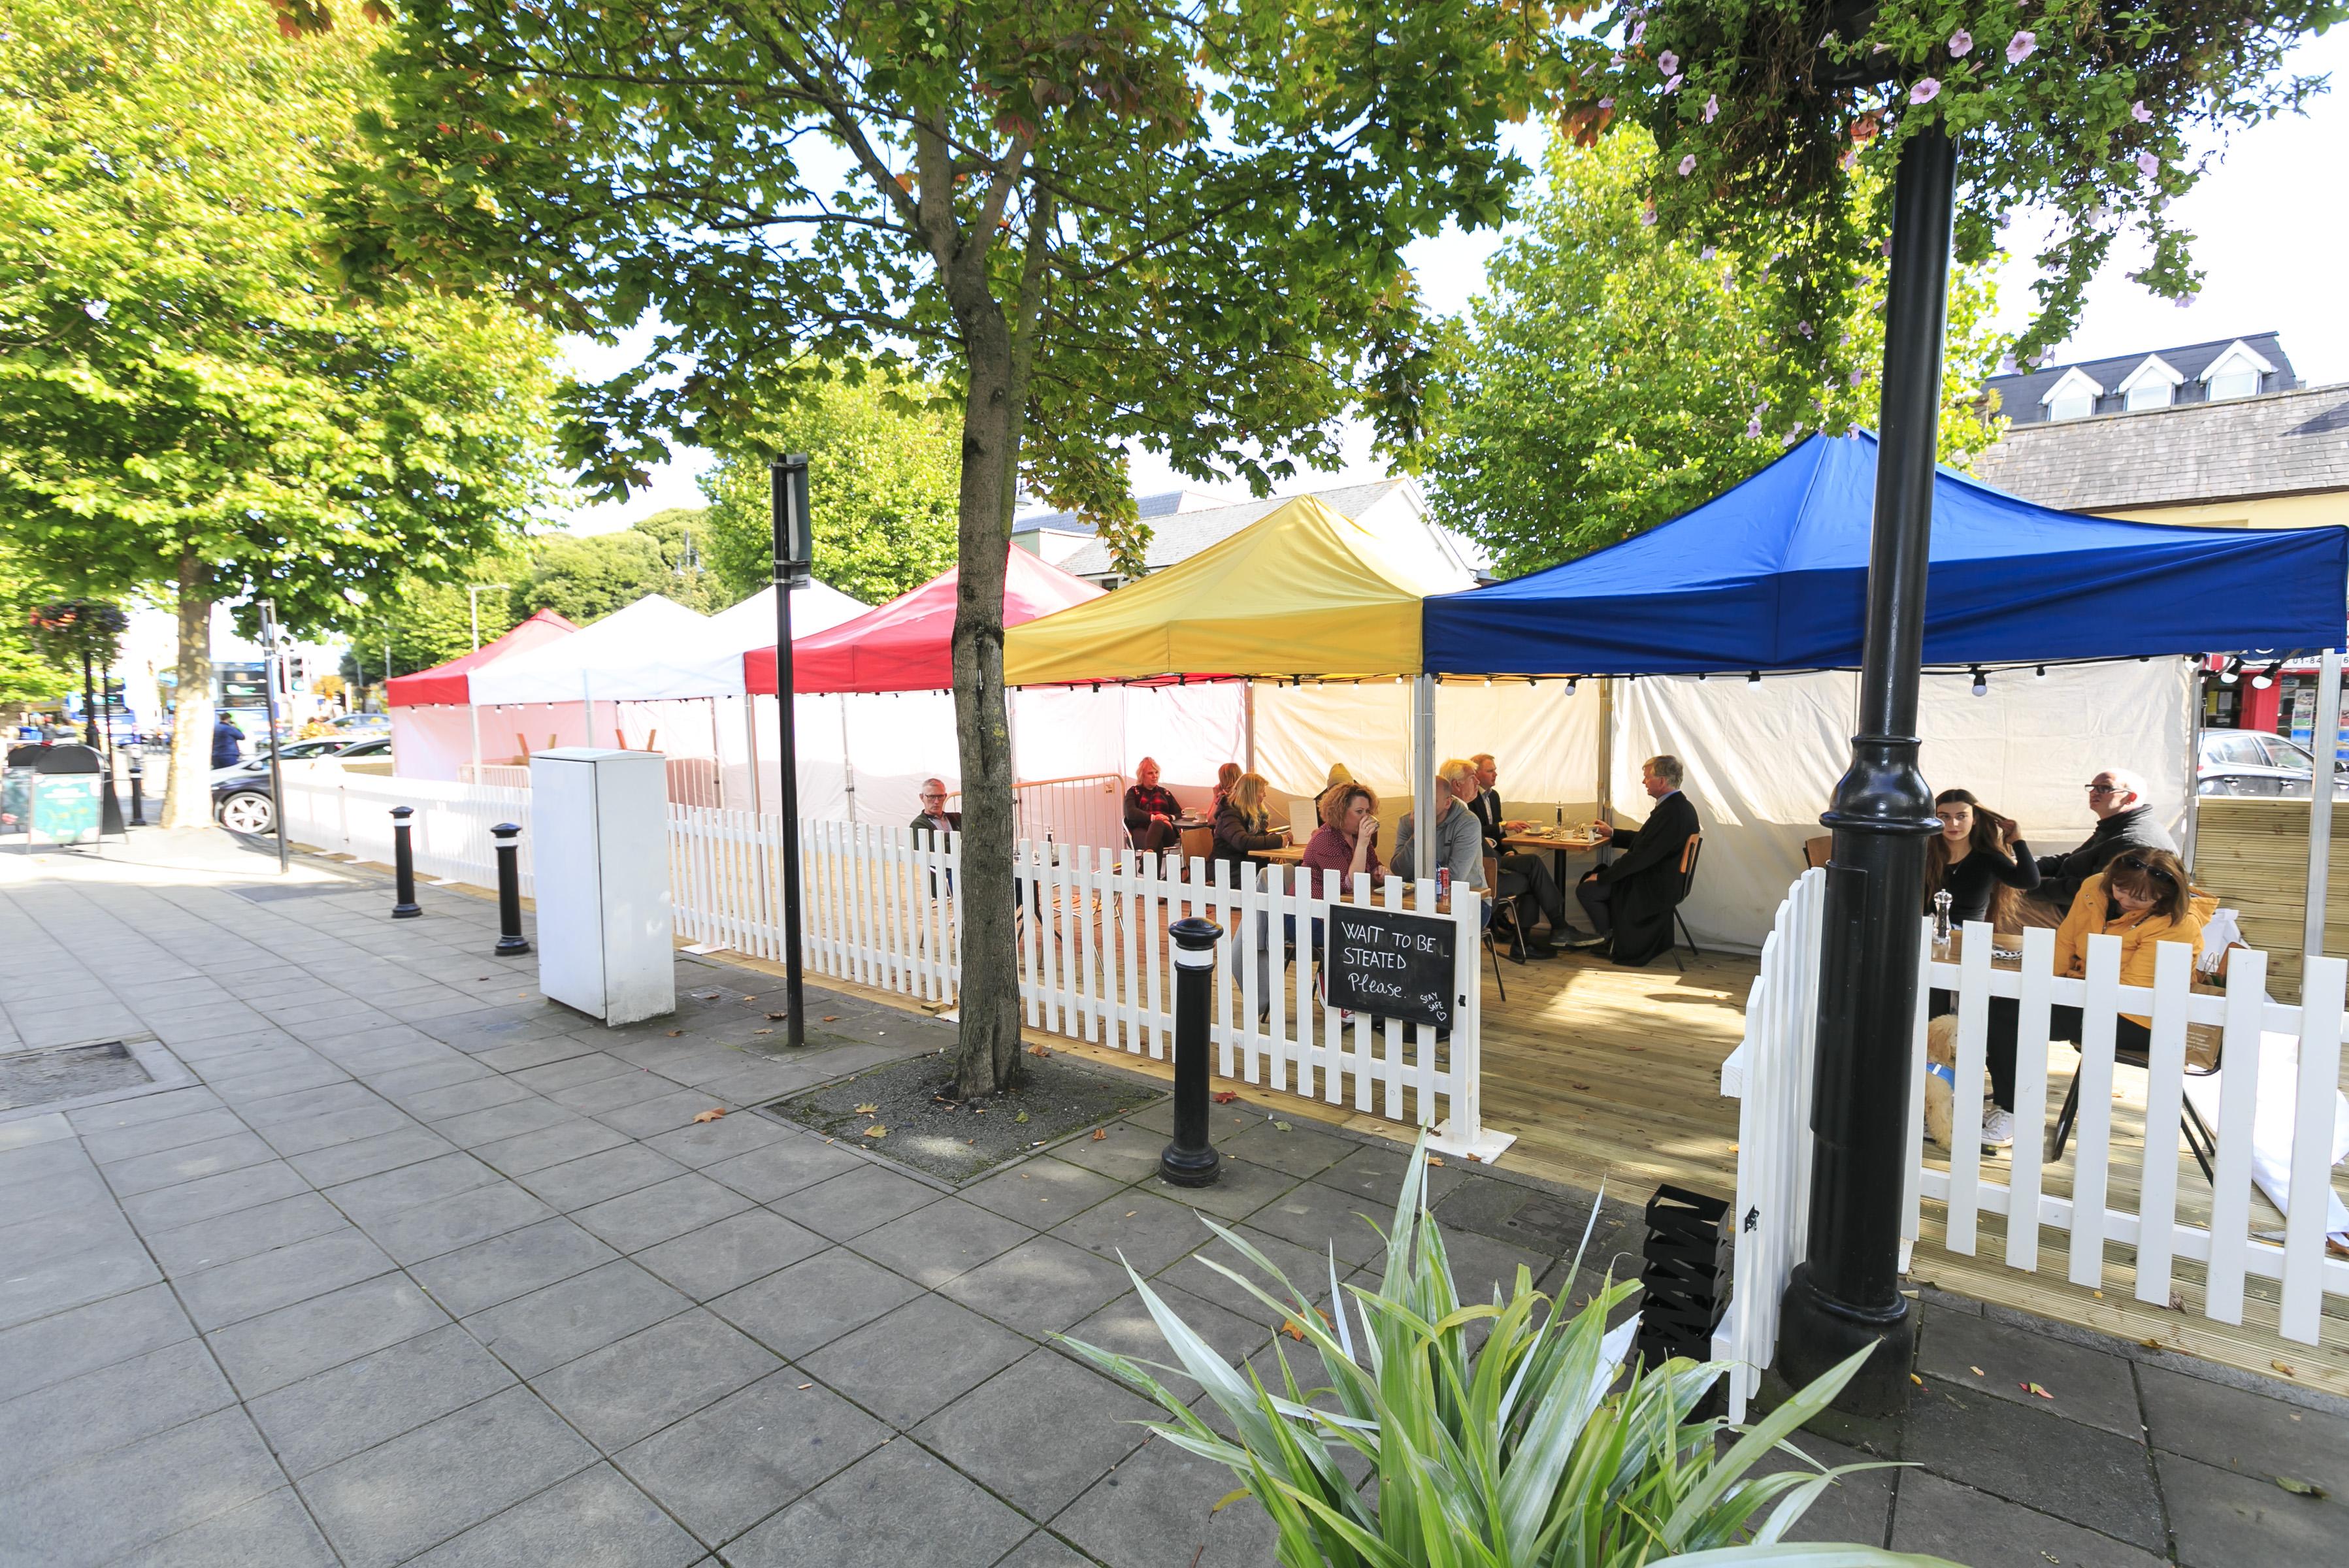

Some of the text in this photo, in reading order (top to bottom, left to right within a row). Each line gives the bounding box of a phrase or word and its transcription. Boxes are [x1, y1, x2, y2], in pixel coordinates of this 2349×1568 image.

[1341, 921, 1436, 953] WAIT TO BE
[1343, 947, 1407, 970] STEATED
[1348, 972, 1407, 998] Please.
[1420, 992, 1438, 1004] STAY
[1428, 1001, 1444, 1012] SAFE
